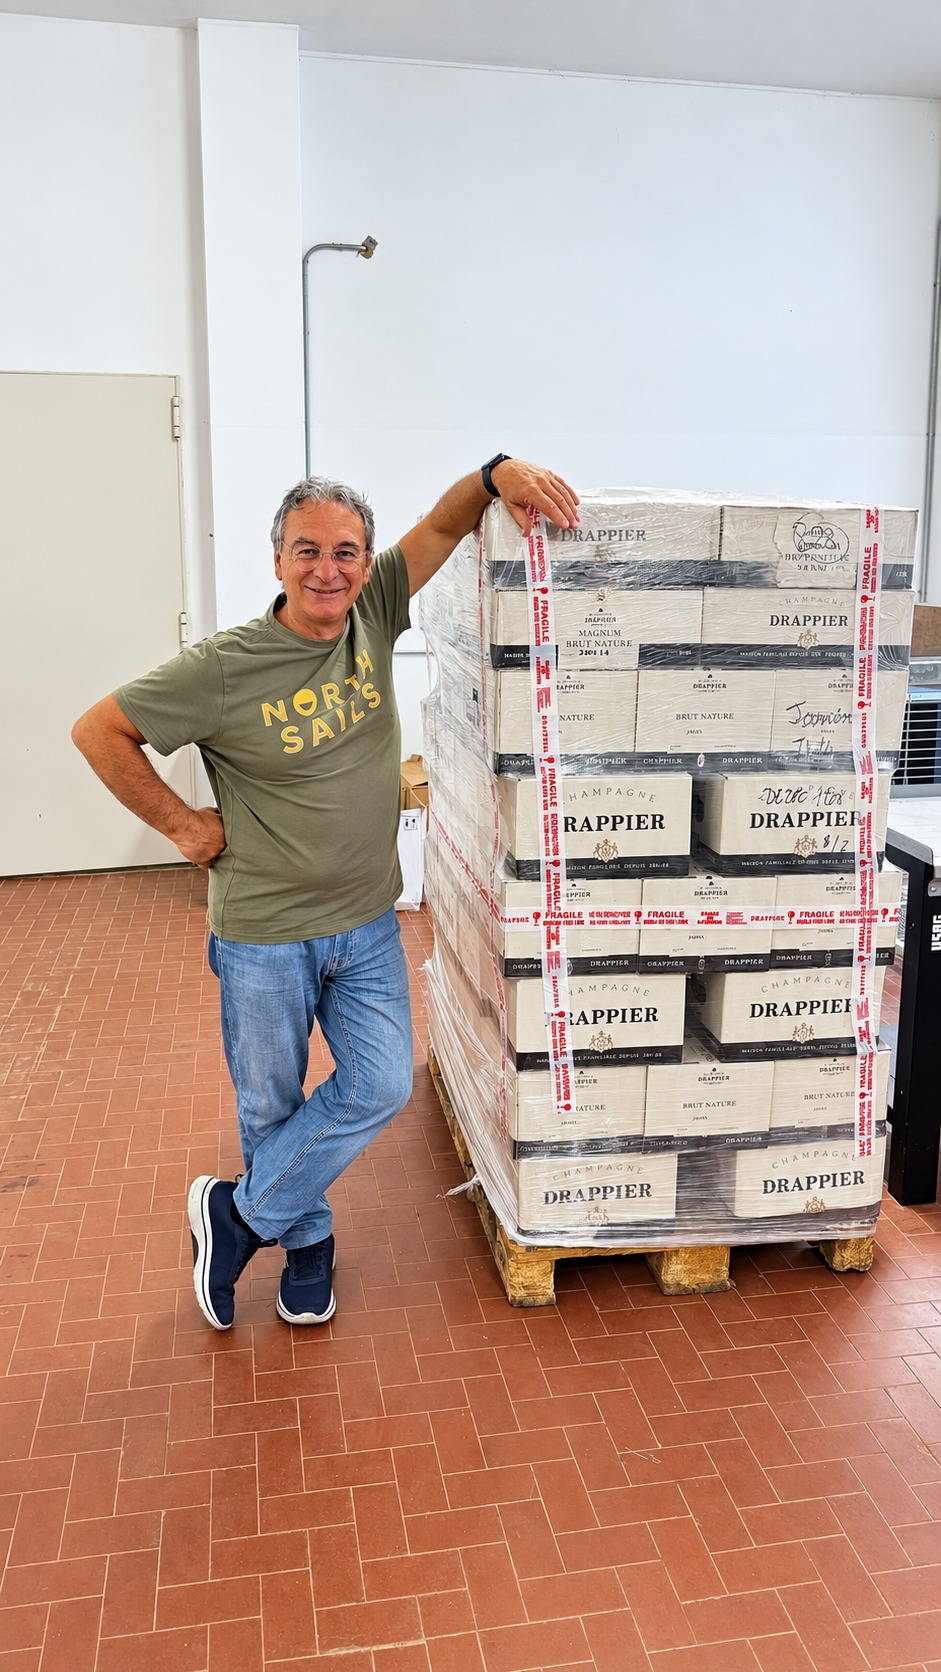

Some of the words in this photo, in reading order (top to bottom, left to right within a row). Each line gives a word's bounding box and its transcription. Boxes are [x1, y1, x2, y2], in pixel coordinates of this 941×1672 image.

[561, 529, 646, 541] DRAPPIER
[540, 600, 550, 643] FRAGILE
[769, 615, 849, 627] DRAPPIER
[579, 629, 621, 637] MAGNUM
[566, 640, 592, 648] BRUT
[594, 640, 632, 648] NATURE
[261, 649, 374, 727] NORTH
[281, 683, 381, 754] SAILS
[701, 712, 734, 720] NATURE
[567, 787, 656, 802] HAMPAGNE
[563, 814, 666, 832] RAPPIER
[749, 811, 861, 828] DRAPPIER
[545, 911, 583, 919] FRAGILE
[799, 910, 835, 918] FRAGILE
[761, 976, 850, 993] CHAMPAGNE
[569, 1007, 659, 1026] RAPPIER
[826, 1091, 855, 1099] NATURE
[705, 1100, 737, 1108] NATURE
[552, 1163, 644, 1182] CHAMPAGNE
[763, 1170, 865, 1194] DRAPPIER
[543, 1183, 653, 1205] DRAPPIER
